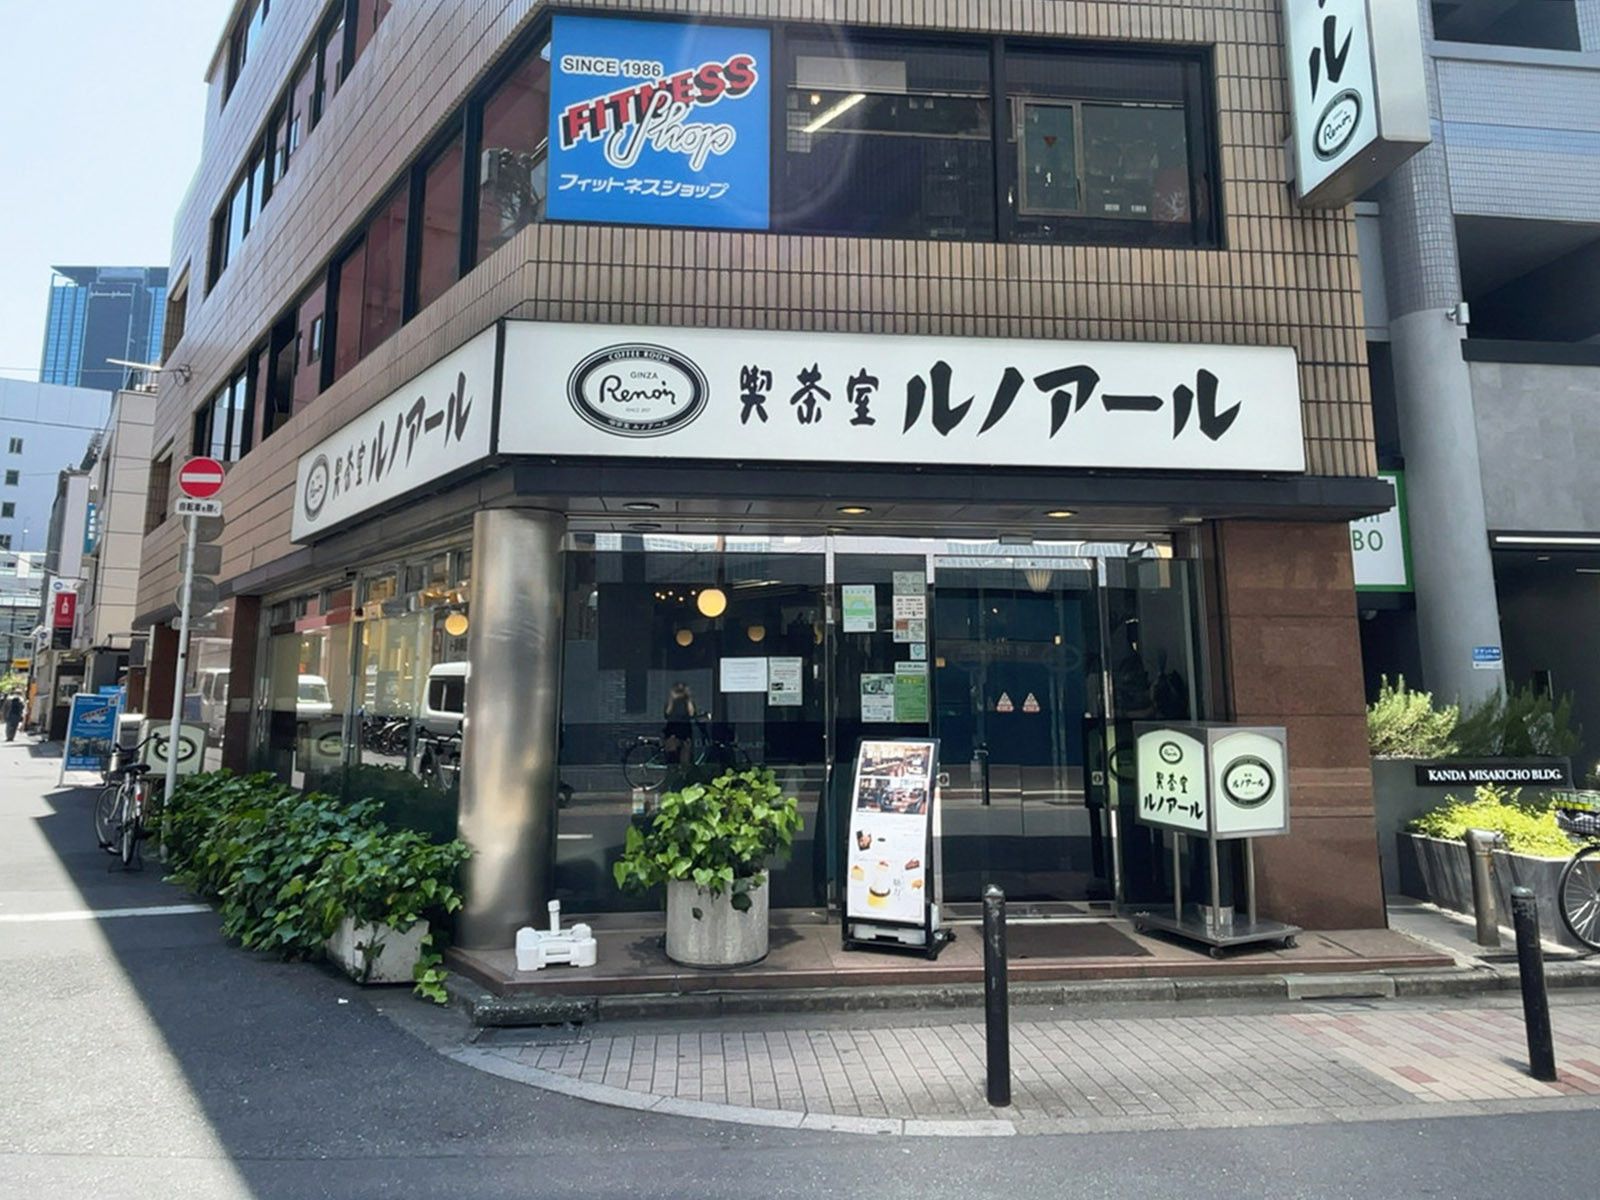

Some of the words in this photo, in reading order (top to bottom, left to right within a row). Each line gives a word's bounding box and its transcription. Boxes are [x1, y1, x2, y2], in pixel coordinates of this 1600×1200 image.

[562, 56, 617, 75] SINCE
[622, 61, 662, 77] 1986
[1309, 0, 1353, 104] ル
[561, 55, 757, 148] FITNESS
[605, 90, 735, 171] Shop
[558, 173, 730, 200] フィットネスショップ
[599, 375, 676, 405] Renoir
[630, 371, 659, 380] GINZA
[740, 362, 880, 427] 喫茶室
[902, 360, 1243, 441] ルノアール
[367, 371, 474, 485] ルノアール
[1428, 769, 1467, 781] KANDA
[1468, 769, 1530, 781] MISAKICHO
[1531, 768, 1563, 780] BLDG.
[1144, 793, 1204, 820] ルノアール
